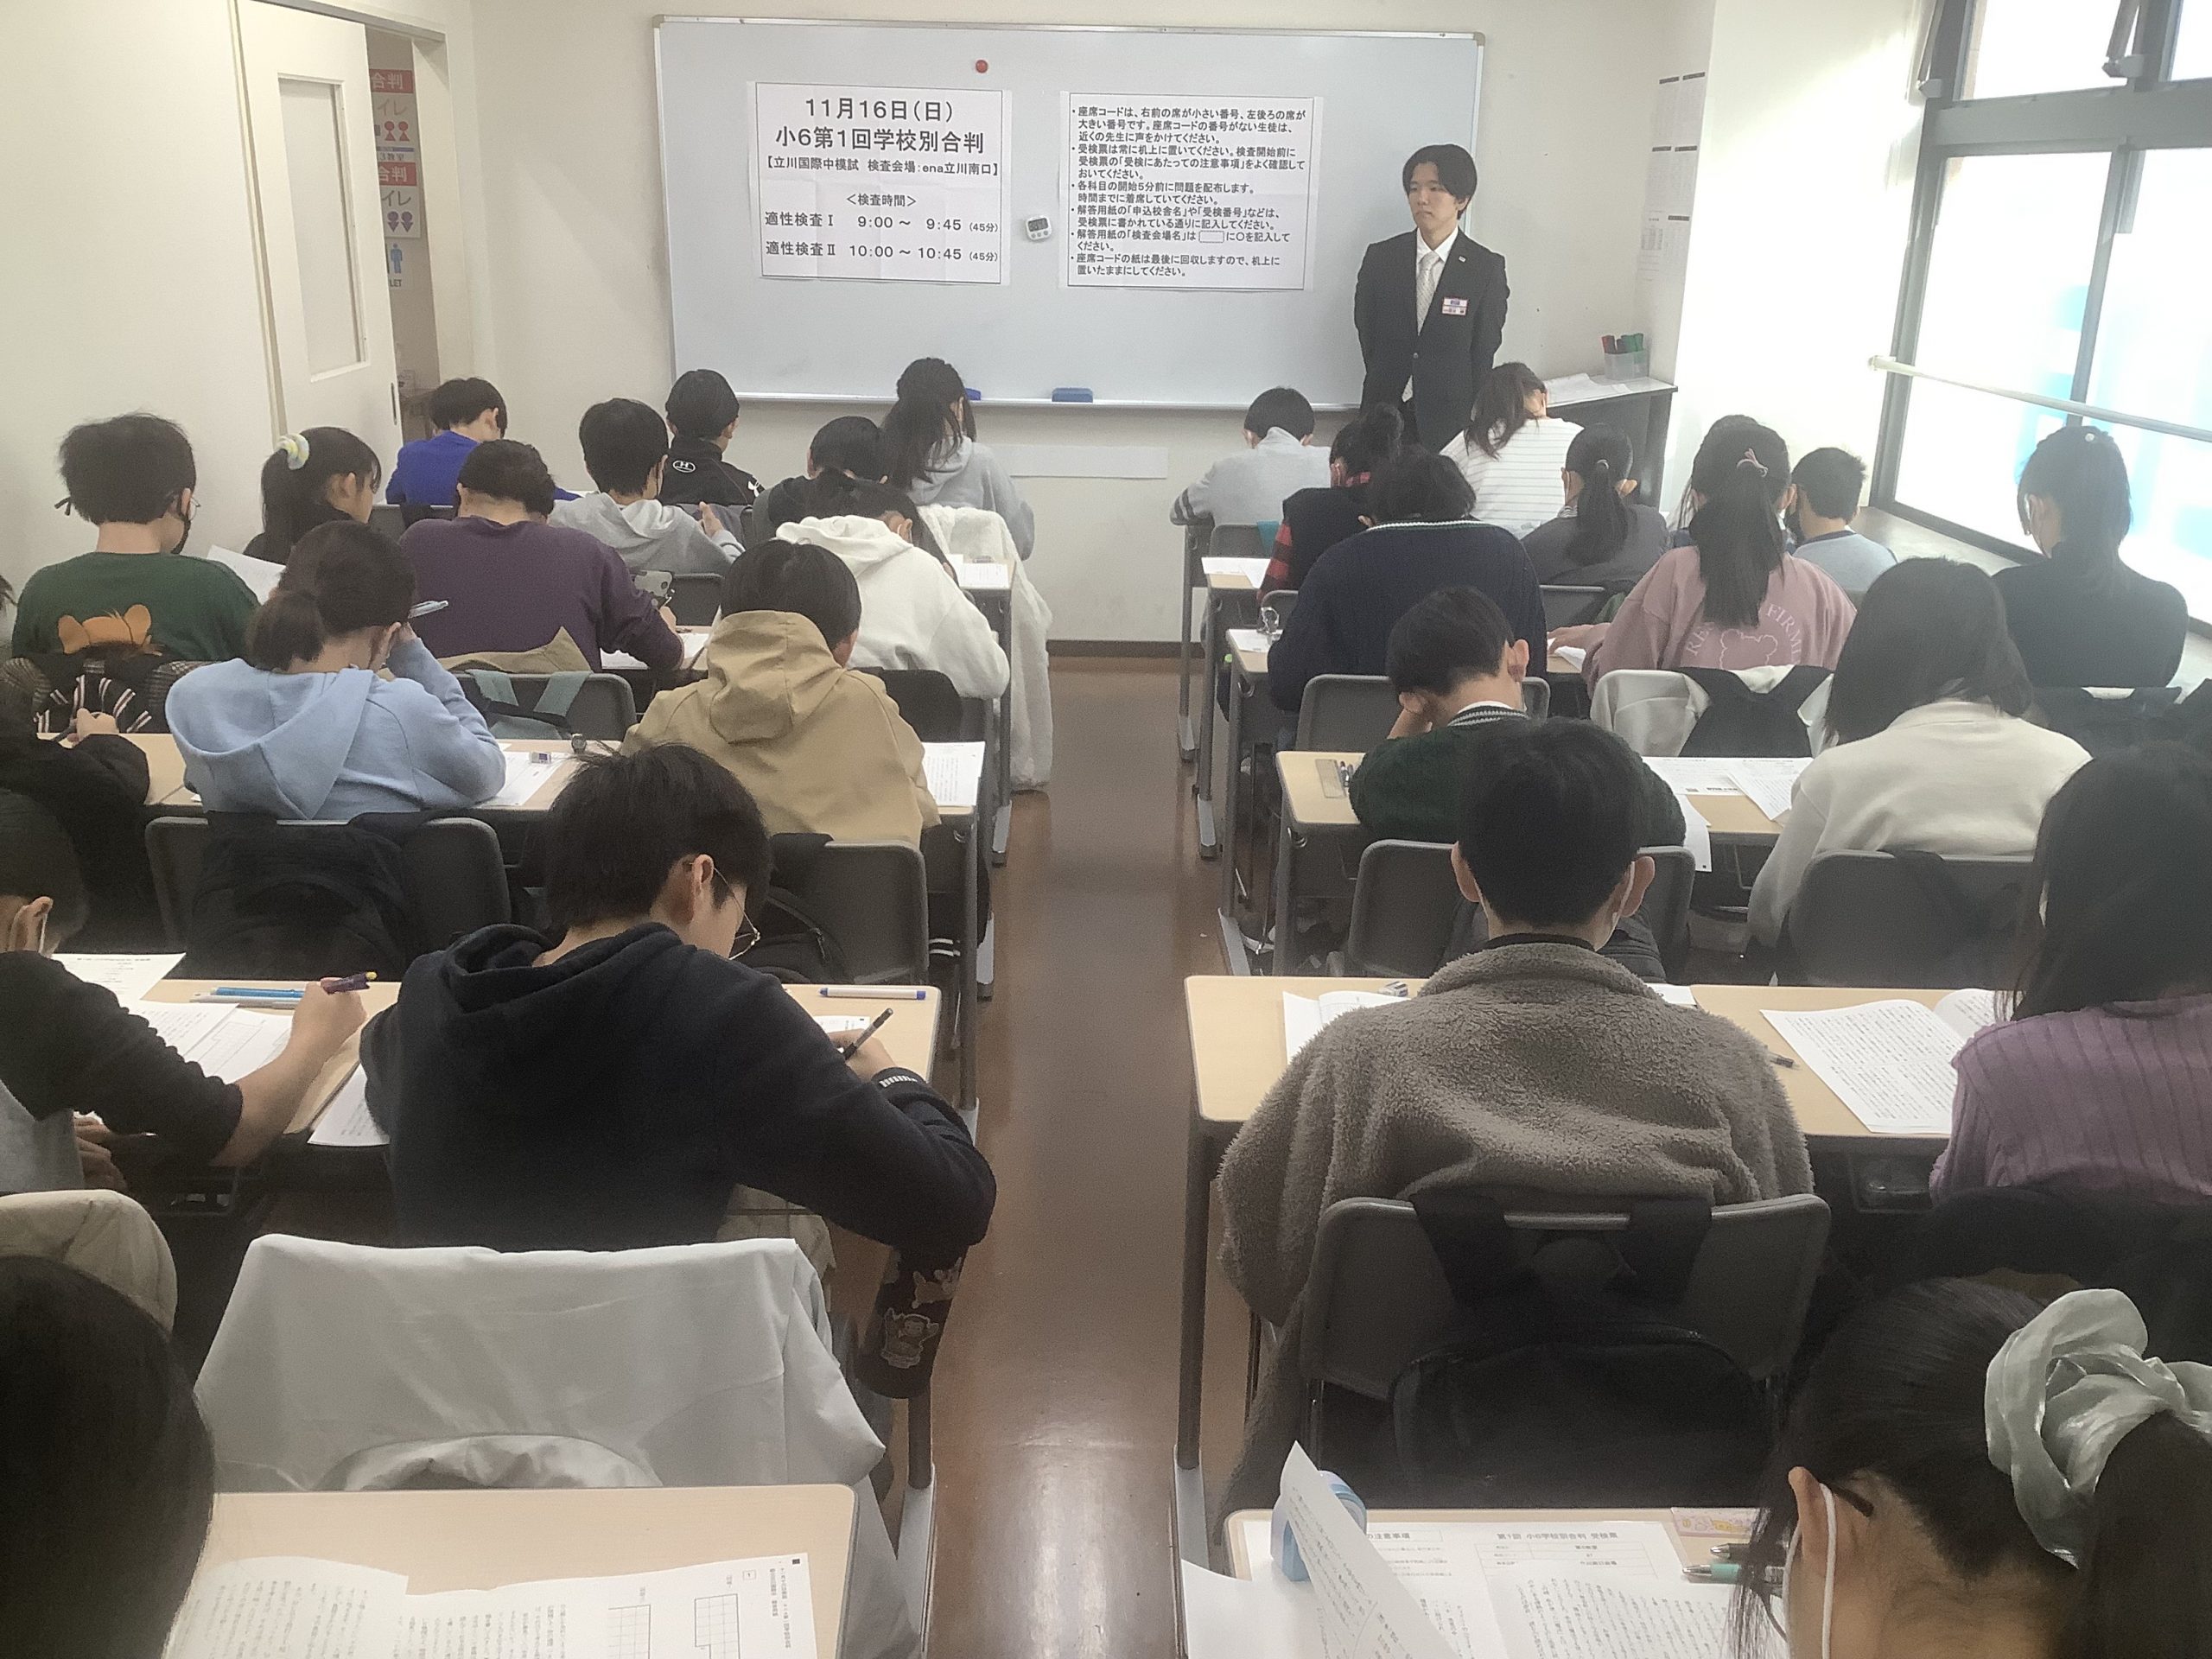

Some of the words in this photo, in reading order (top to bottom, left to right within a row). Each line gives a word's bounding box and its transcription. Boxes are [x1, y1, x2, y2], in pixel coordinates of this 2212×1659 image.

[805, 98, 954, 123] 11月16日(日)
[775, 126, 984, 154] 小6第1回学校別合判
[767, 156, 859, 171] 【立川国際中模試
[1078, 168, 1143, 180] おいてください。
[846, 194, 917, 207] ＜検査時間＞
[765, 212, 834, 227] 適性検査Ⅰ
[857, 216, 893, 228] 9:00
[926, 219, 962, 231] 9:45
[969, 223, 998, 233] (45分)
[766, 241, 836, 257] 適性検査Ⅱ
[849, 245, 893, 257] 10:00
[918, 247, 962, 260] 10:45
[969, 251, 998, 263] (45分)
[1077, 241, 1114, 251] ください。
